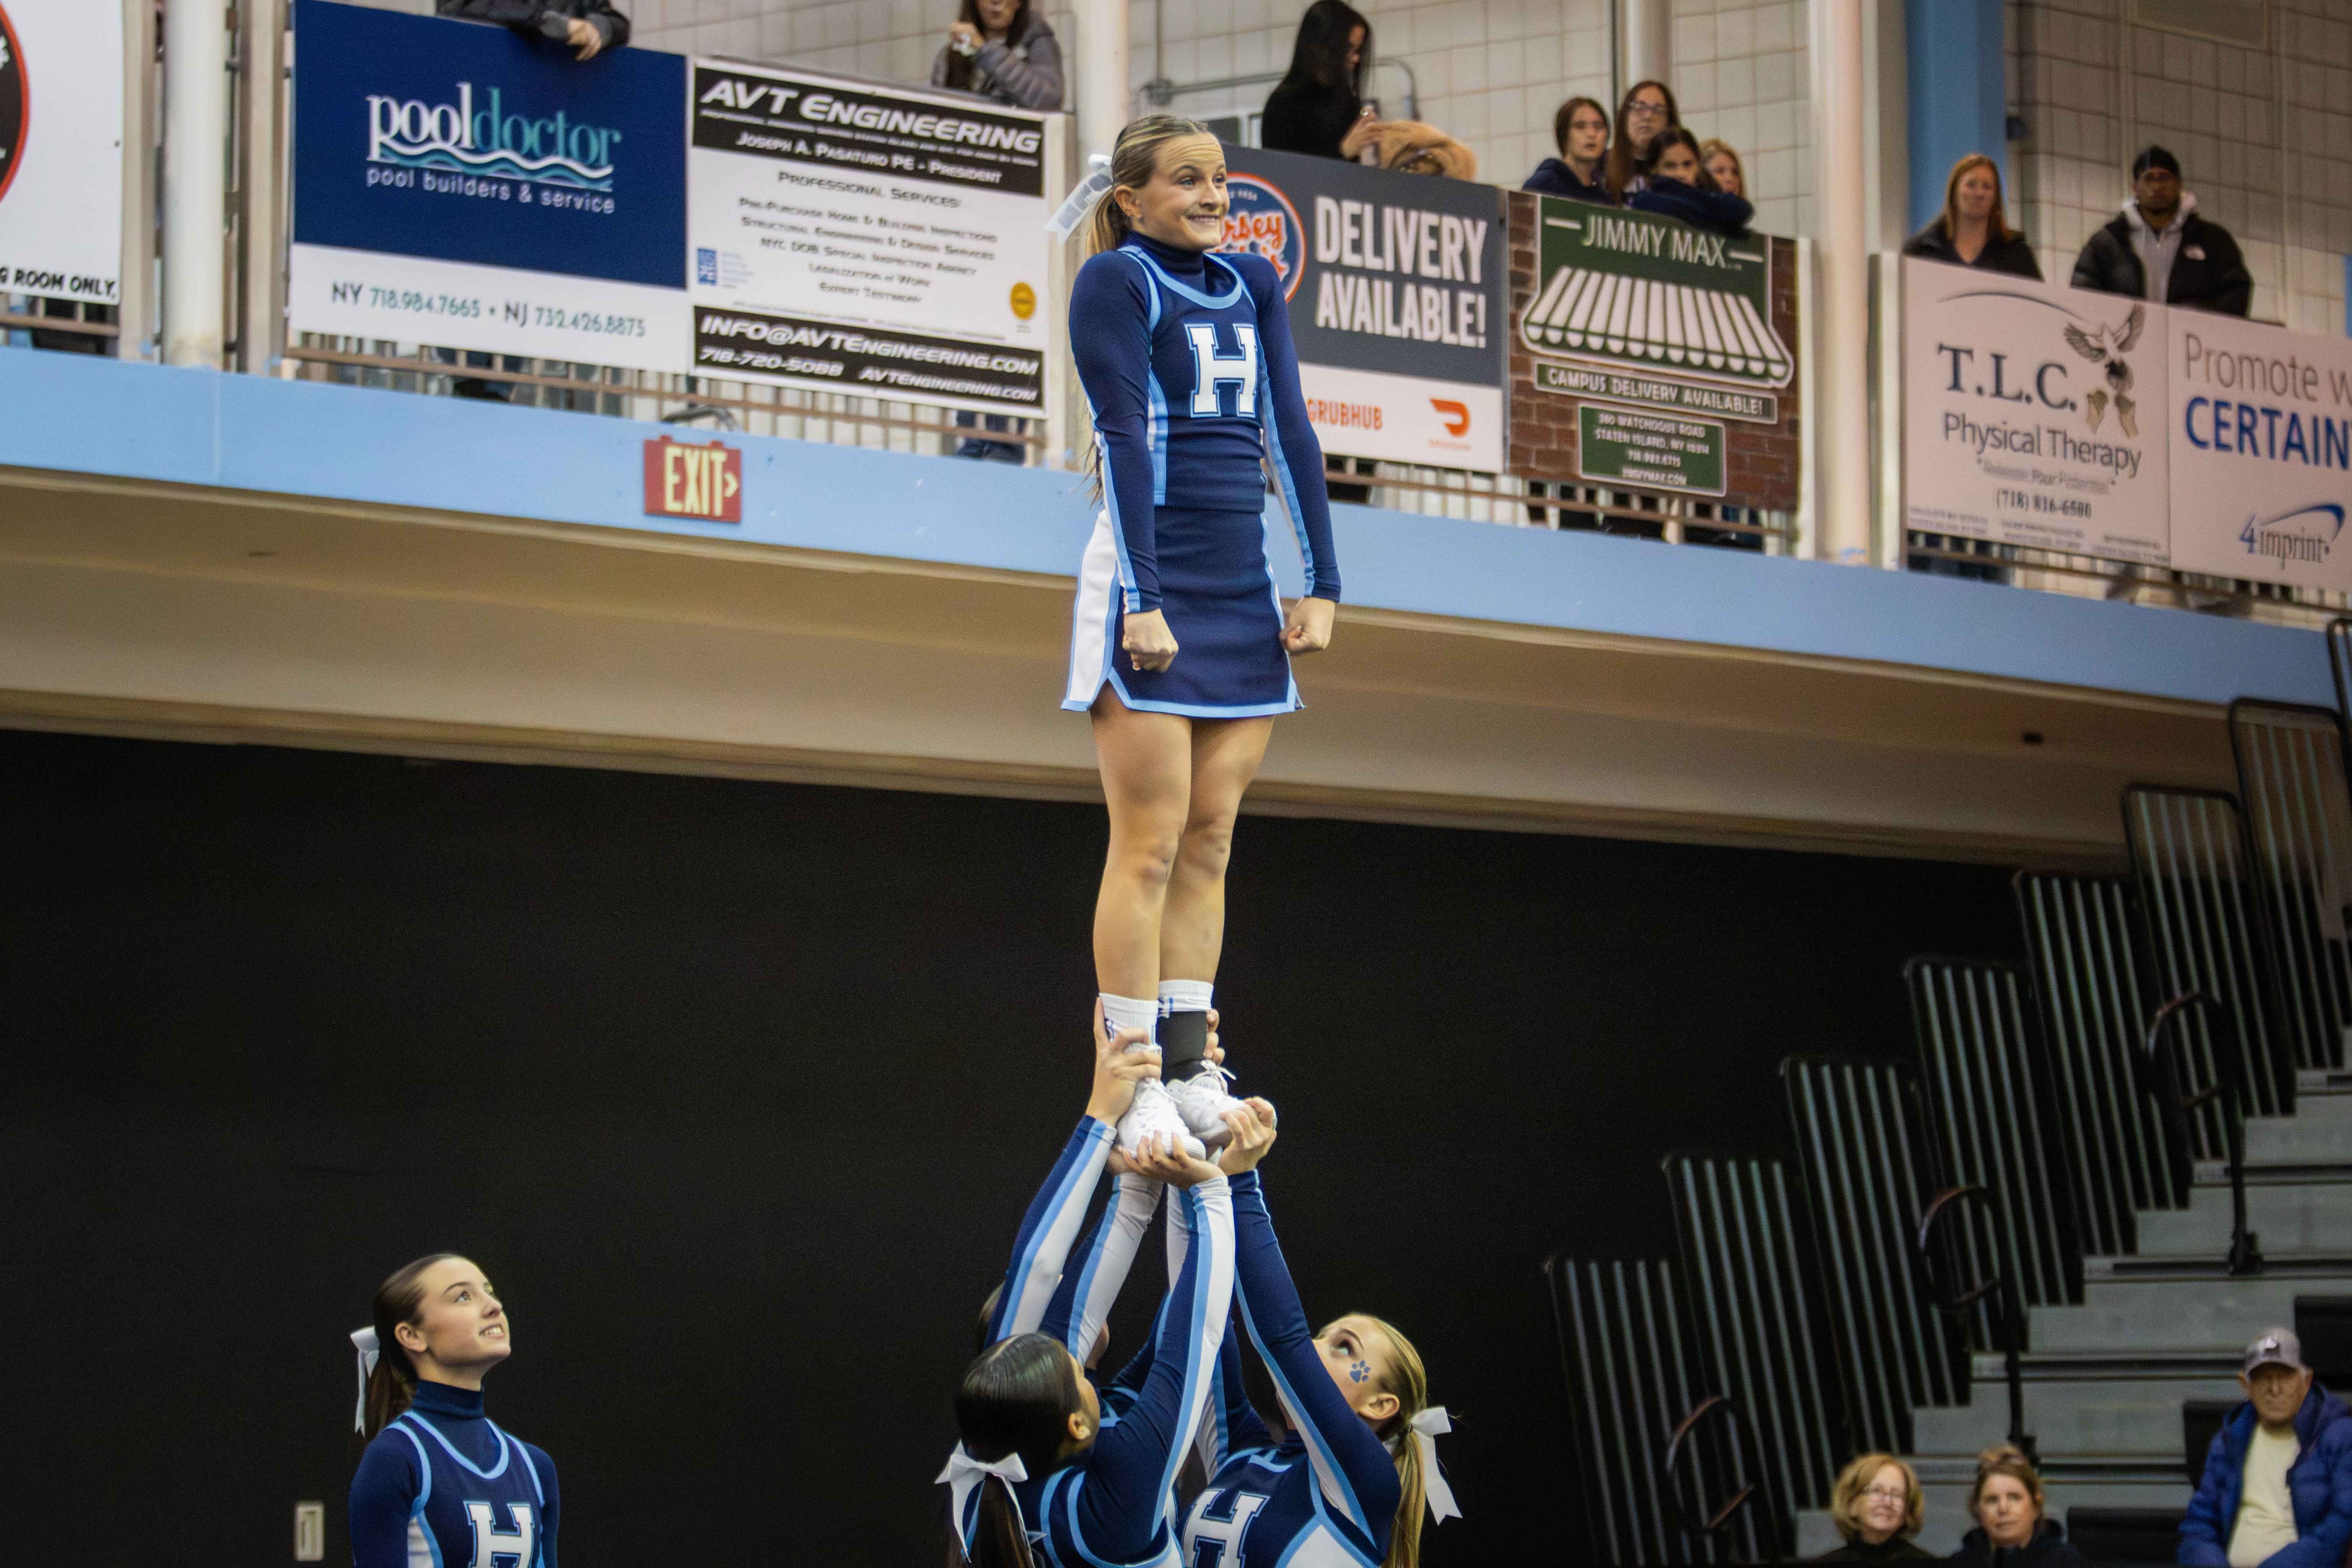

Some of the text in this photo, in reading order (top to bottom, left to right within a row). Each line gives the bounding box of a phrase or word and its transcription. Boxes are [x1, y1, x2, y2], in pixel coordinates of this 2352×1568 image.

[700, 78, 798, 114] AVT
[800, 94, 1041, 153] ENGINEERING
[366, 166, 615, 215] pool builders & service
[736, 131, 793, 152] JOSEPH
[890, 155, 915, 171] PE
[928, 159, 1002, 184] PRESIDENT
[778, 171, 884, 197] PROFESSIONAL
[1315, 195, 1488, 284] DELIVERY
[1581, 214, 1726, 269] JIMMY MAX
[14, 269, 65, 291] ROOM
[332, 281, 363, 305] NY
[505, 301, 527, 327] NJ
[1316, 272, 1487, 348] AVAILABLE!
[1185, 323, 1258, 418] H
[1548, 367, 1763, 416] CAMPUS DELIVERY AVAILABLE!
[1937, 343, 2077, 412] T.L.C.
[2184, 332, 2319, 402] Promote
[1307, 398, 1382, 431] GRUBHUB
[1944, 412, 2042, 456] Physical
[2047, 428, 2142, 479] Therapy
[2186, 396, 2352, 471] CERTAIN
[665, 446, 727, 516] EXIT
[1997, 488, 2029, 512] (718)
[464, 1501, 535, 1568] H
[1182, 1488, 1271, 1568] H
